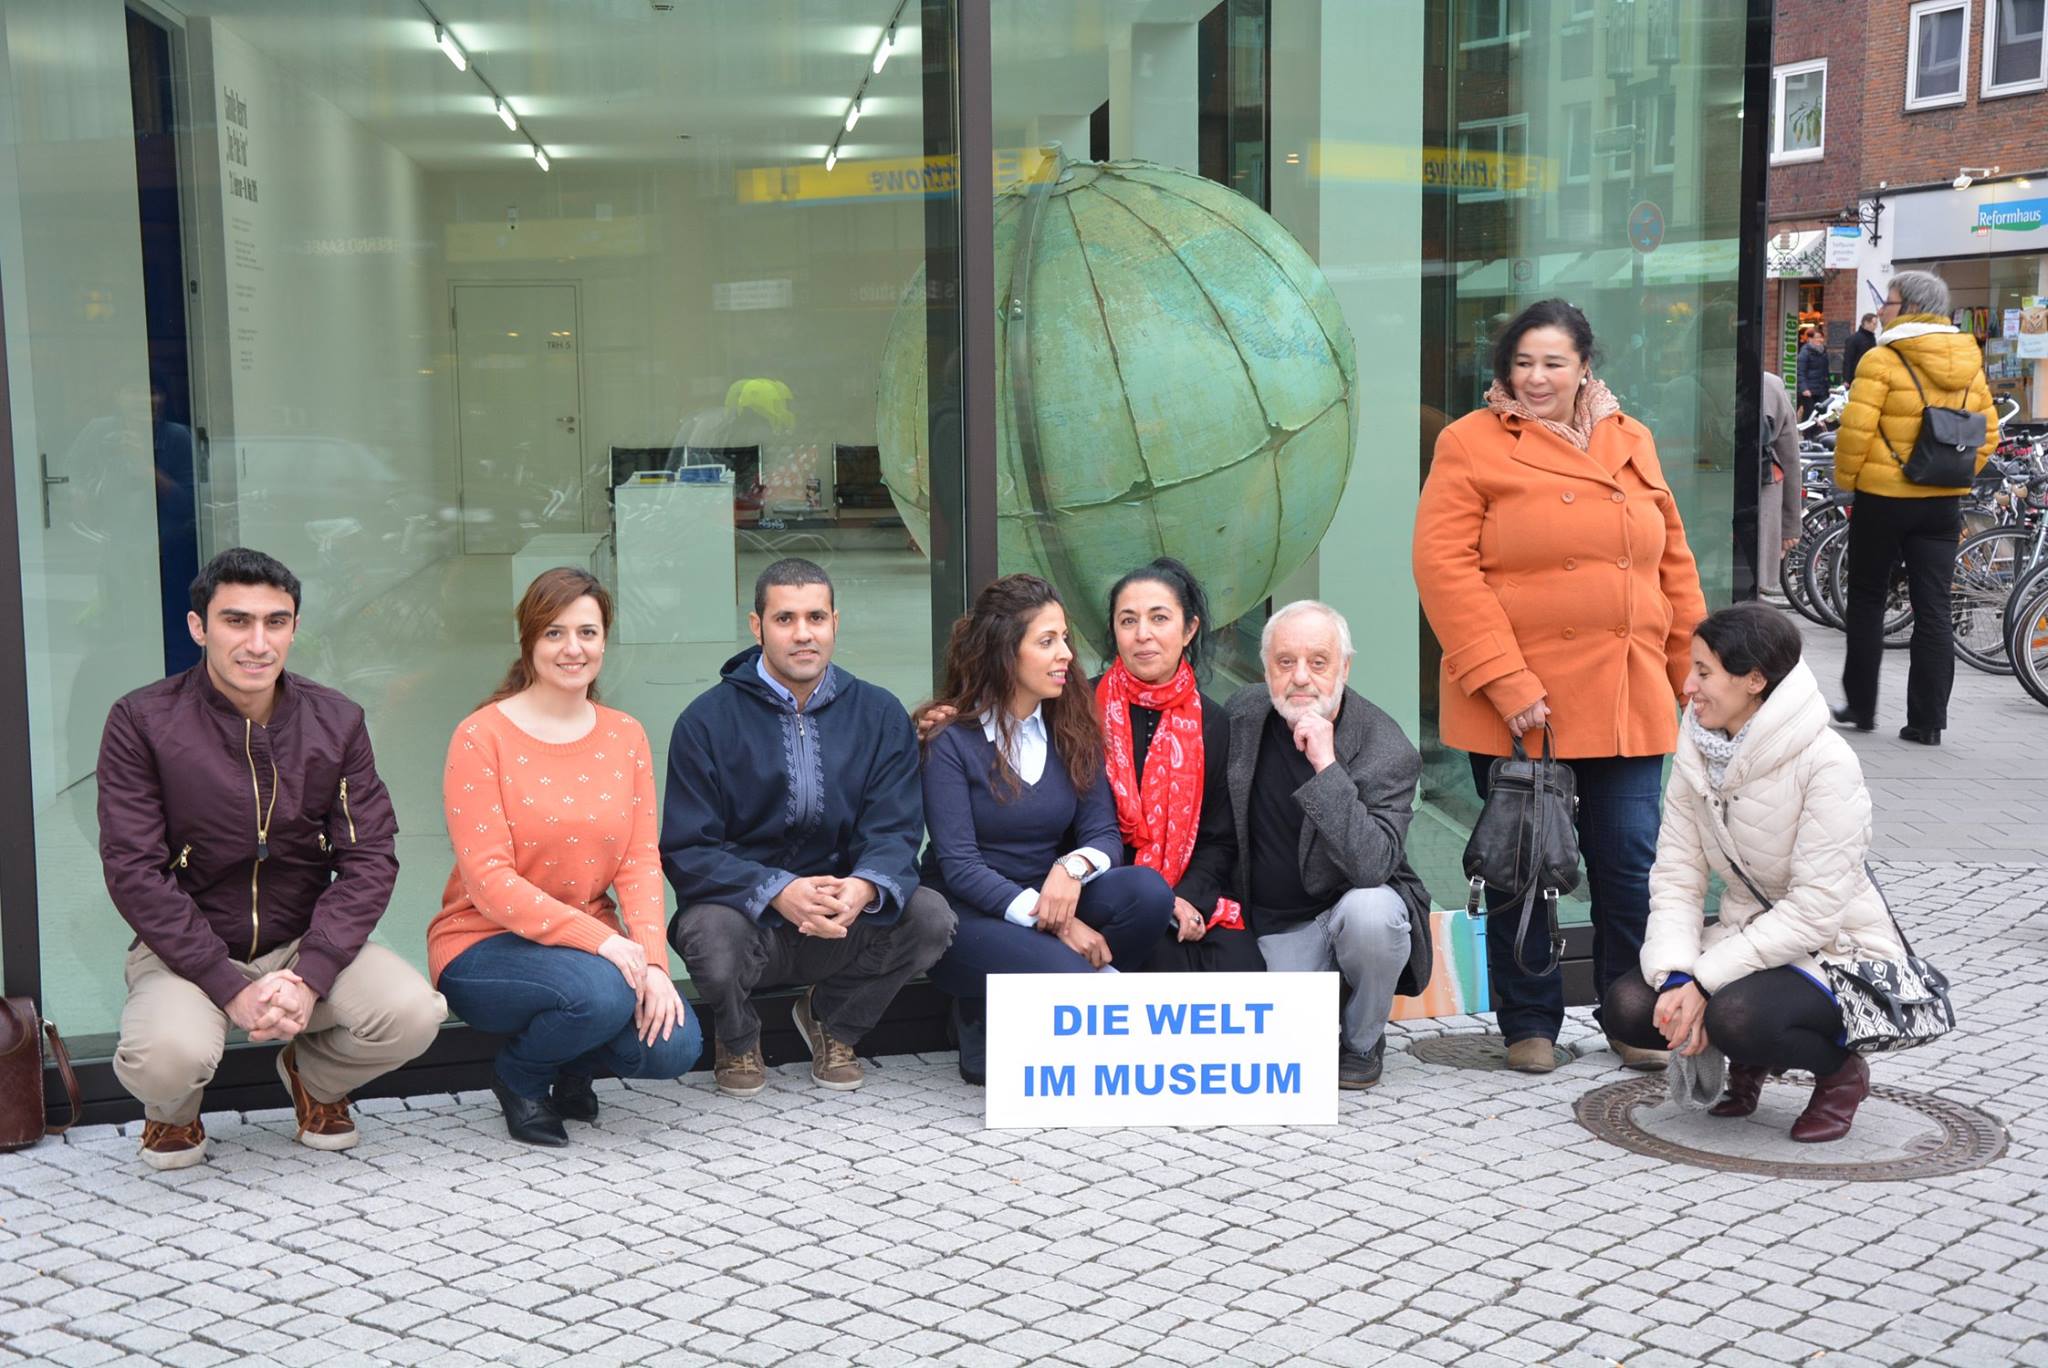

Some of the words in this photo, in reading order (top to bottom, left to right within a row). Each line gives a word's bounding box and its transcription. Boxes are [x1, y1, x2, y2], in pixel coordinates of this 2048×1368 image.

[1979, 208, 2041, 230] Reformhaus
[1054, 1005, 1129, 1036] DIE
[1146, 1003, 1274, 1035] WELT
[1024, 1066, 1075, 1097] IM
[1095, 1063, 1301, 1096] MUSEUM
